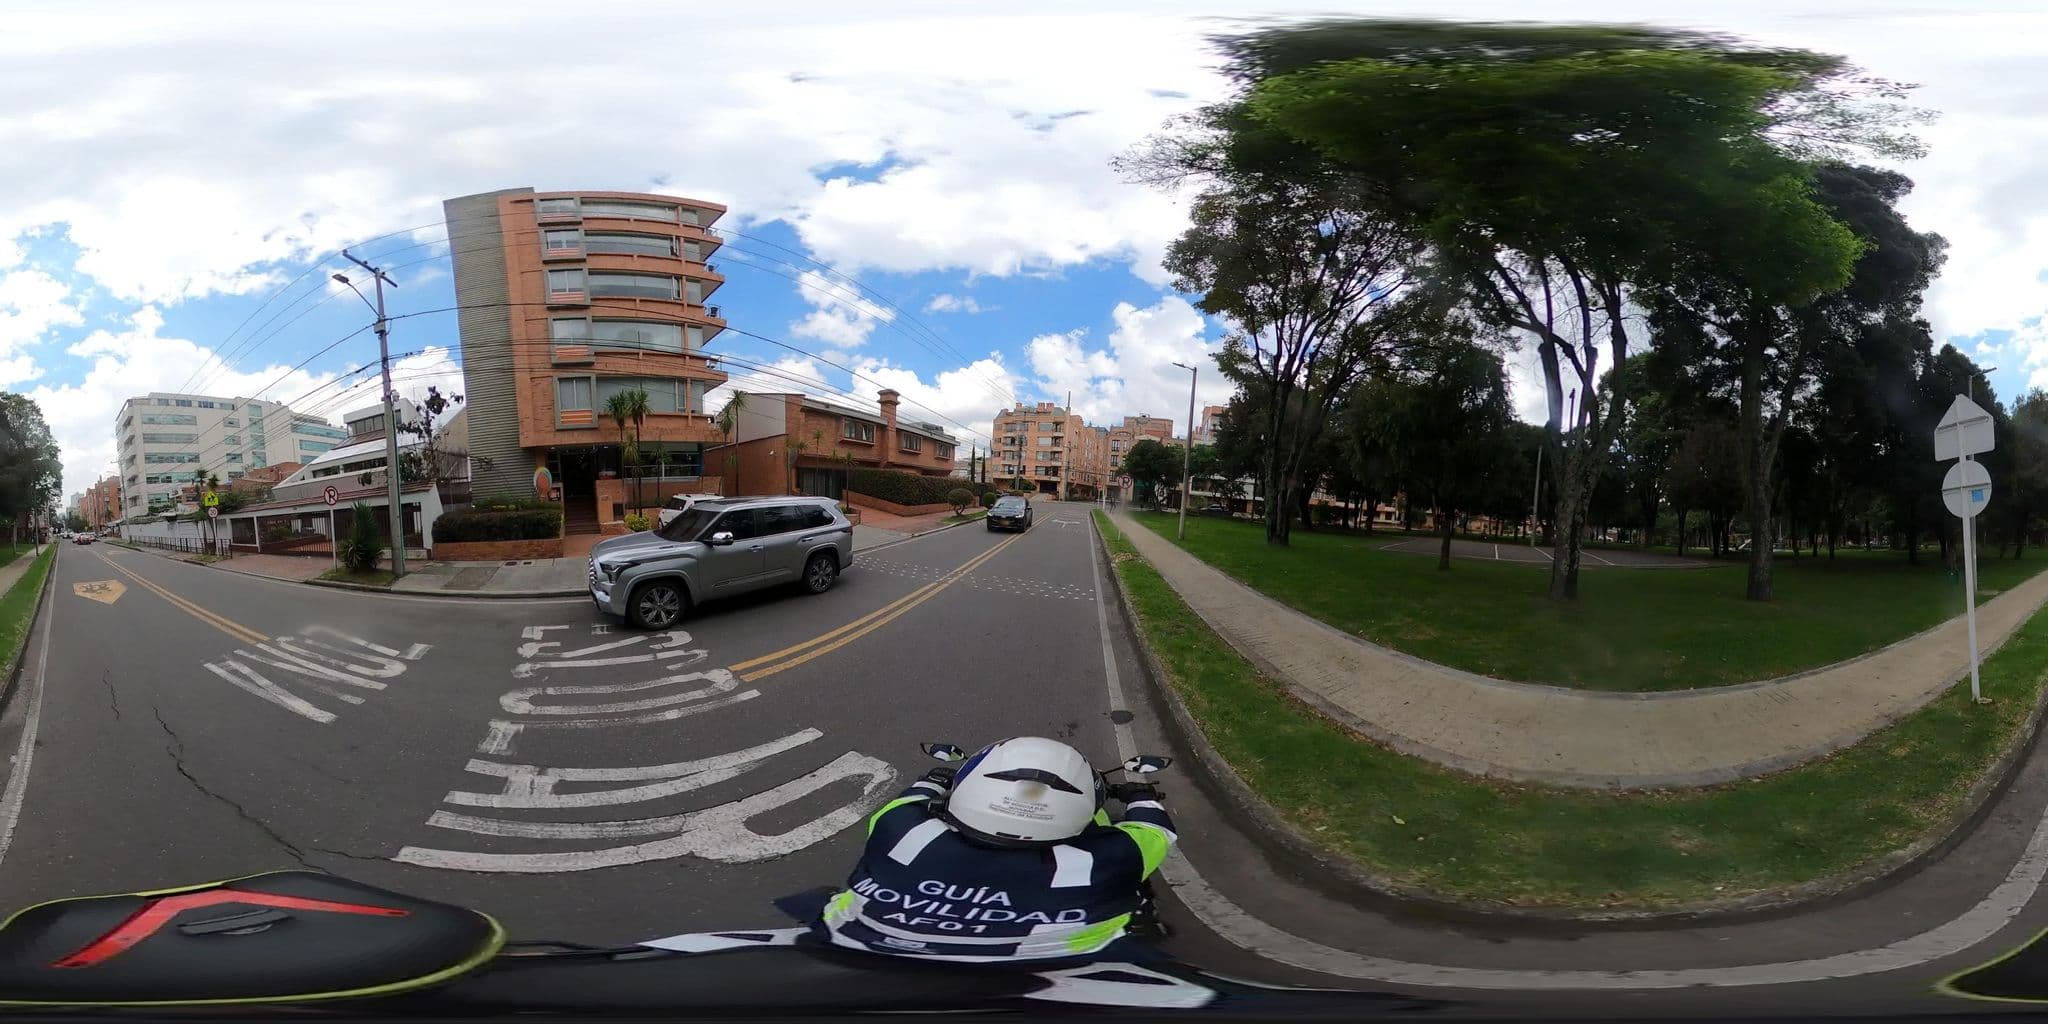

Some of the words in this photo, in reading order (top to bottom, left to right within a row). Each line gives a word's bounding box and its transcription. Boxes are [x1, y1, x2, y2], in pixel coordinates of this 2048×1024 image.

[203, 624, 434, 724] ZONA
[854, 877, 1088, 923] MOVILIDAD
[918, 880, 1011, 907] GUÍA
[882, 912, 988, 934] AF01
